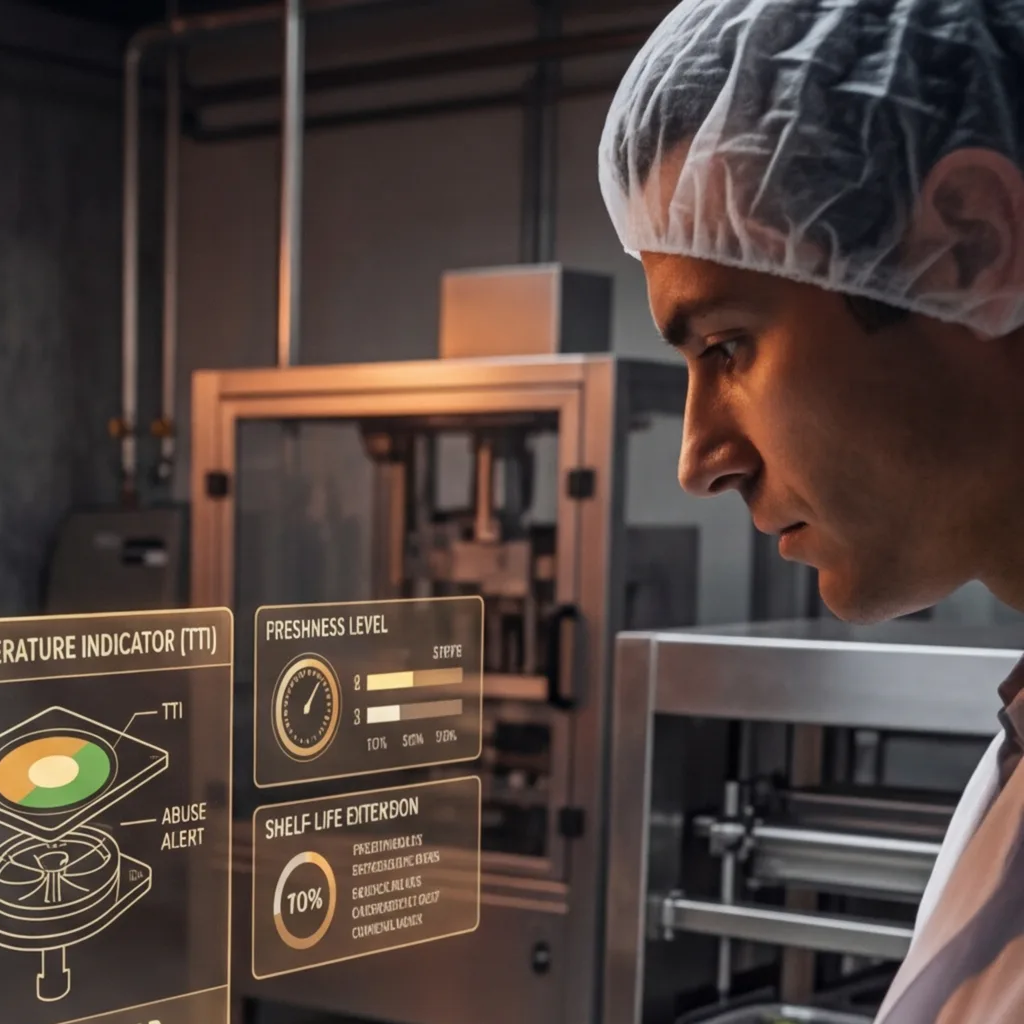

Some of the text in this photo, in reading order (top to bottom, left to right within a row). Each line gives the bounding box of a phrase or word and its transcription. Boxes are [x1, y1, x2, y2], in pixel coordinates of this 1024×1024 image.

[349, 614, 389, 635] LEVEL
[81, 628, 175, 659] INDICATOR
[180, 625, 217, 657] (TTI)
[162, 701, 183, 720] TTI
[161, 802, 207, 825] ABUSE
[264, 812, 312, 840] SHELF
[314, 807, 343, 831] LIFE
[160, 827, 205, 851] ALERT
